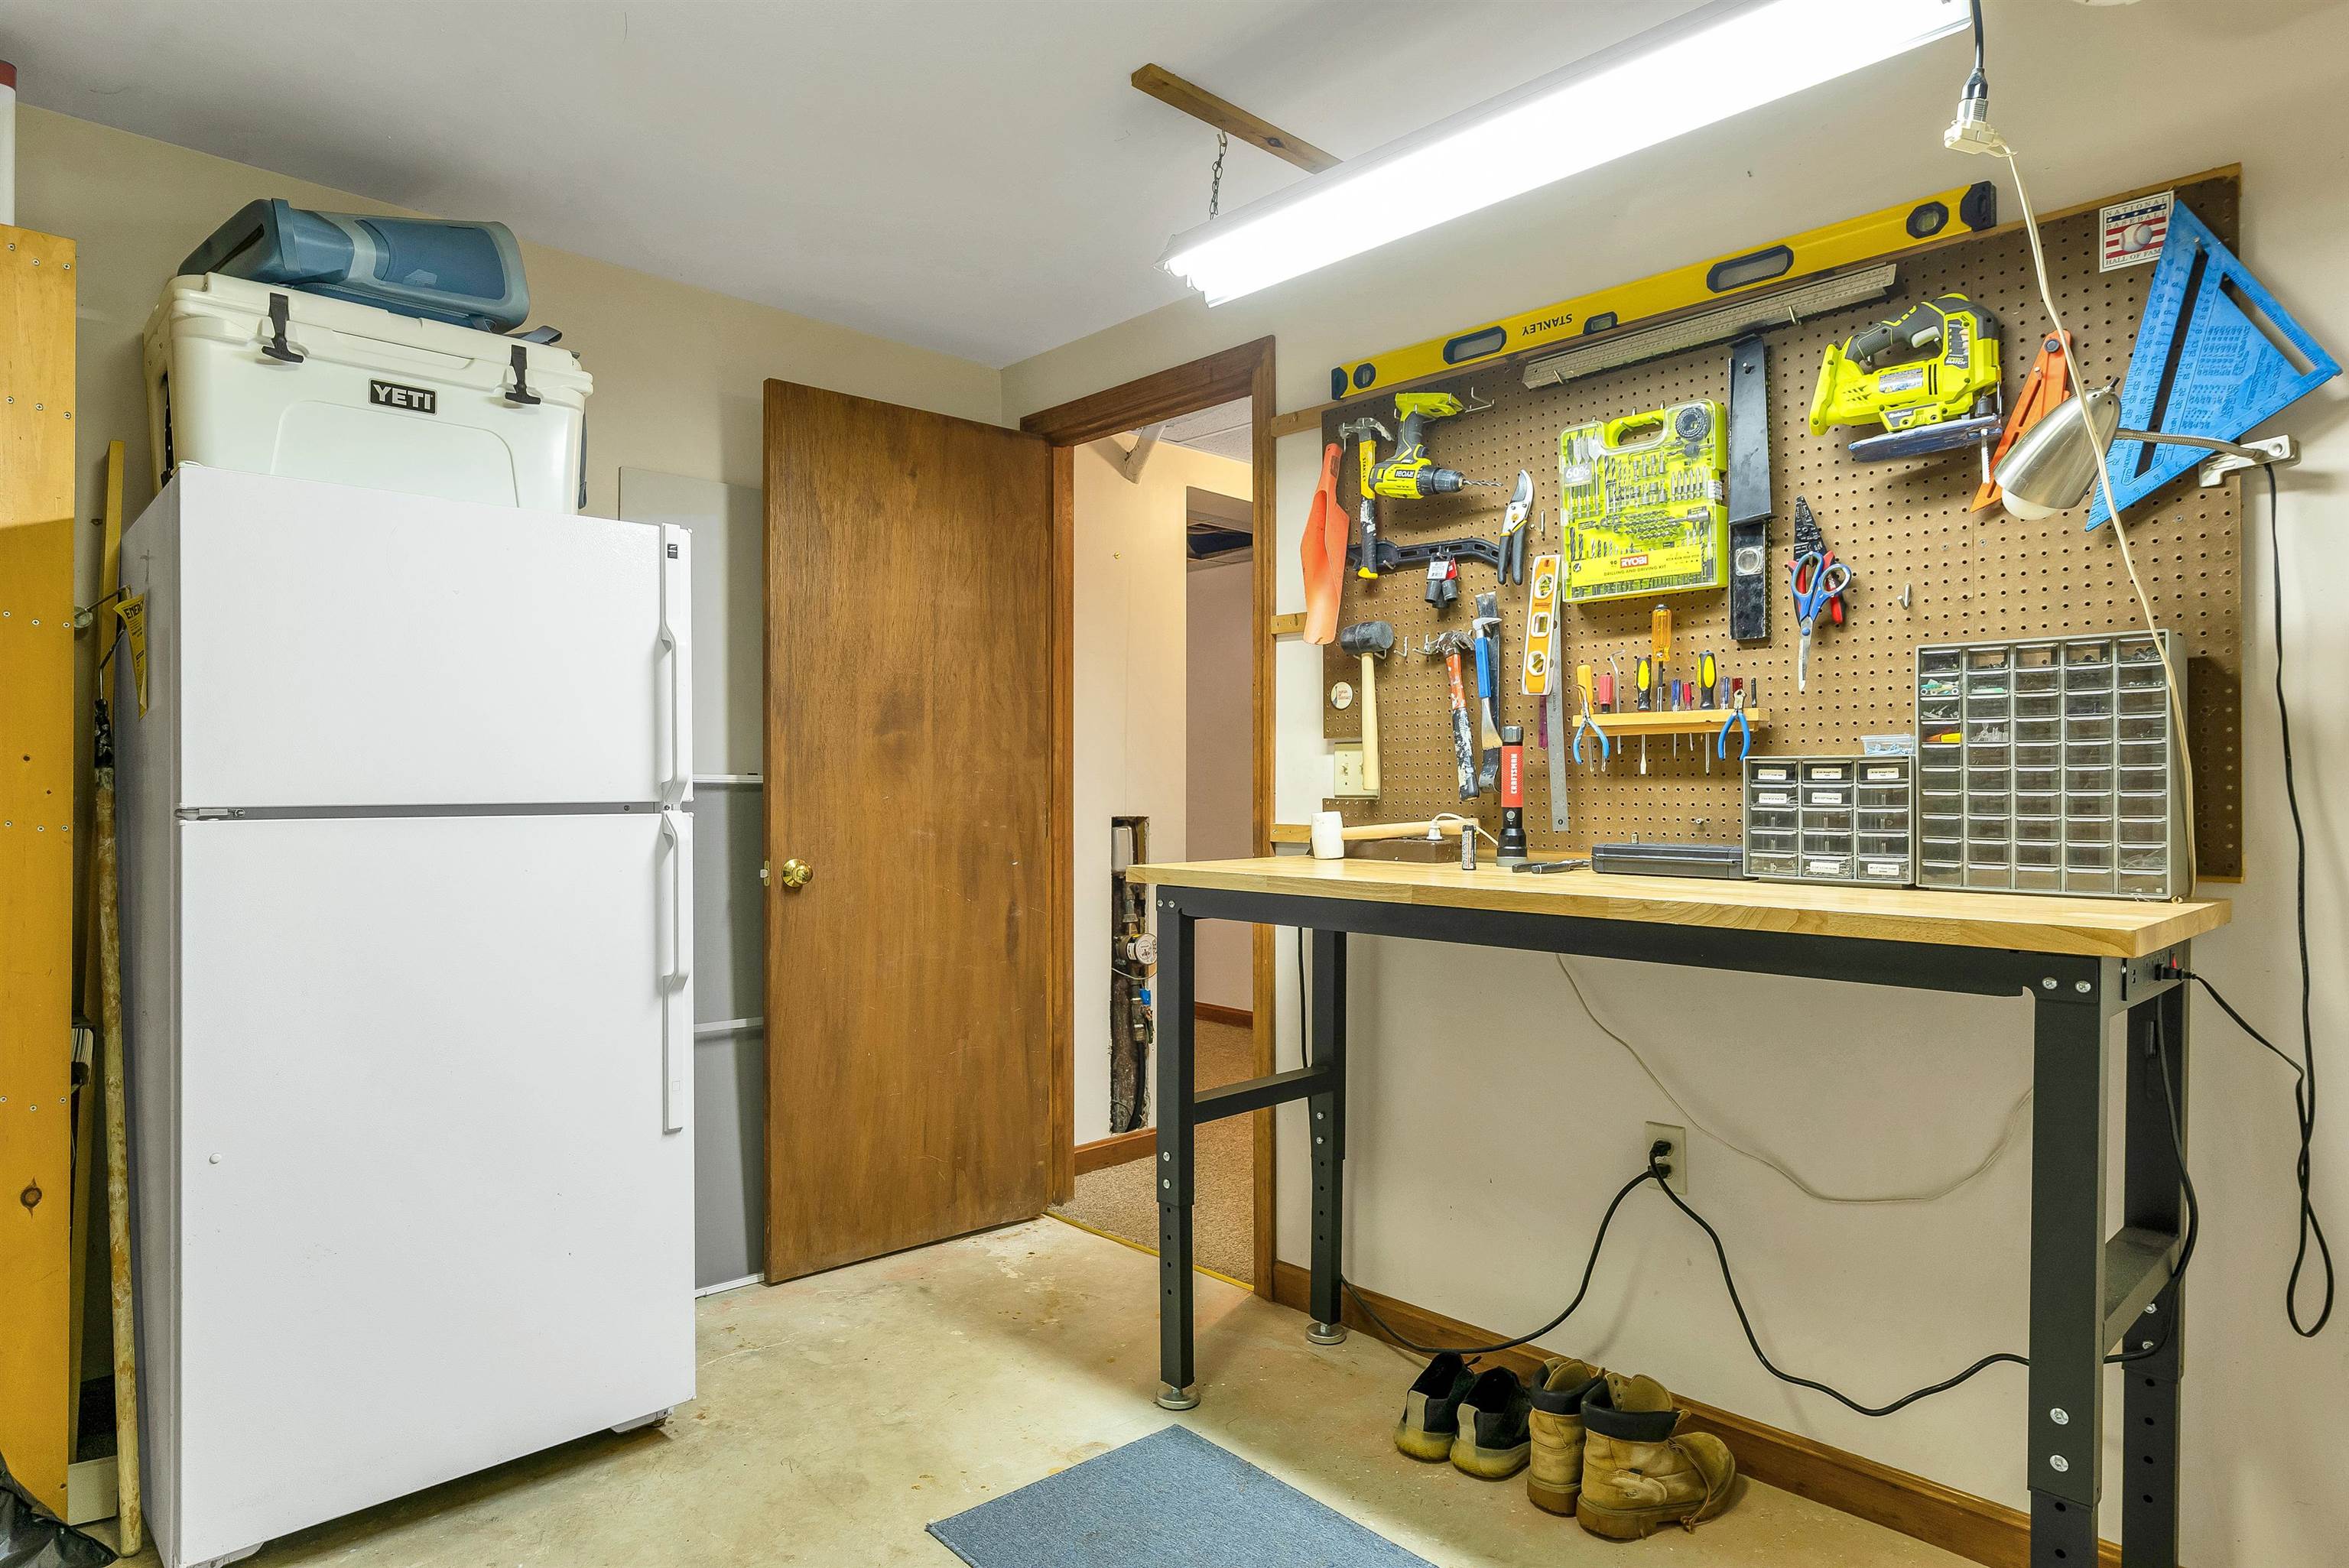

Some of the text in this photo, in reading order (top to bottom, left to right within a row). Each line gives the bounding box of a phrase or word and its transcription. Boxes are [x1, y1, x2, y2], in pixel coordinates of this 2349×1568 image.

[2106, 197, 2167, 217] NATIONAL
[2106, 211, 2168, 229] BASEBALL
[2106, 256, 2128, 265] HALL
[2143, 248, 2162, 257] FAM
[1522, 313, 1573, 336] STANLEY
[372, 384, 431, 410] YETI
[1565, 464, 1590, 479] 60%
[1620, 555, 1648, 567] RYOBI
